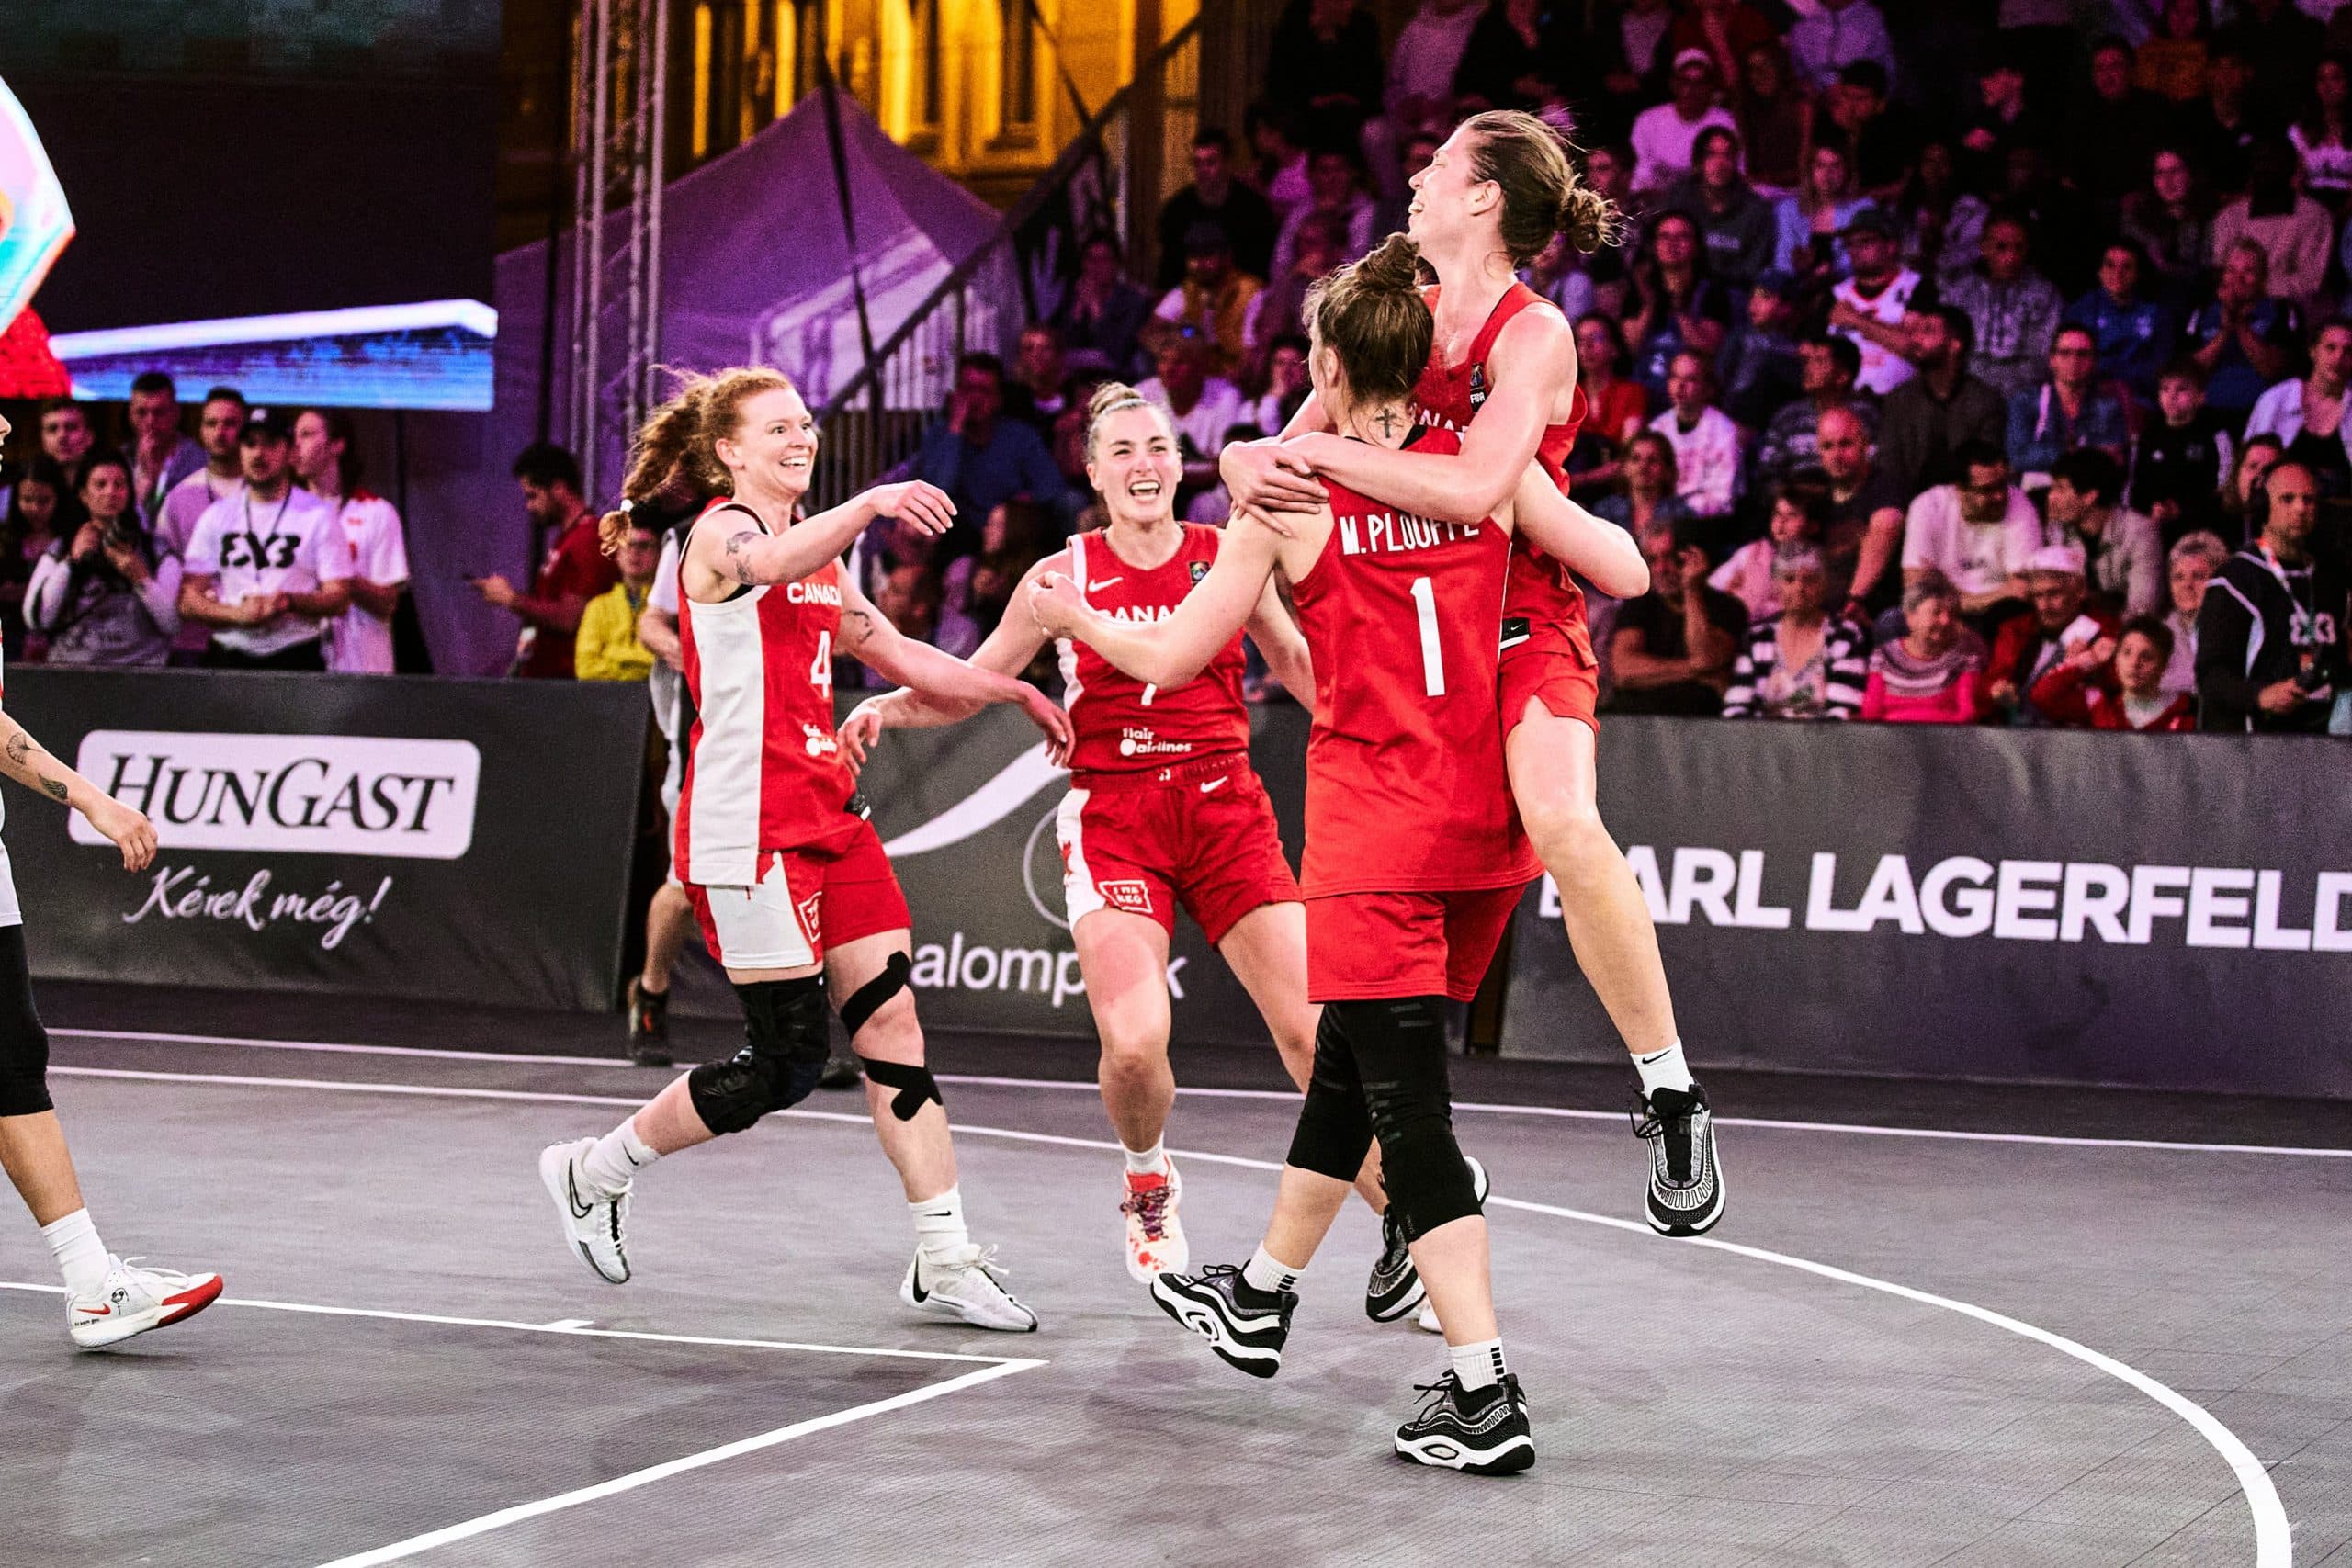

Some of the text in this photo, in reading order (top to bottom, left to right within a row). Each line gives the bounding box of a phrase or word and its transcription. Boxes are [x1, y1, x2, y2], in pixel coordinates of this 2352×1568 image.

[786, 581, 842, 606] CANAD
[810, 630, 832, 699] 4
[1409, 577, 1445, 696] 1
[1136, 740, 1192, 753] airlines
[123, 865, 393, 950] Kérek még!
